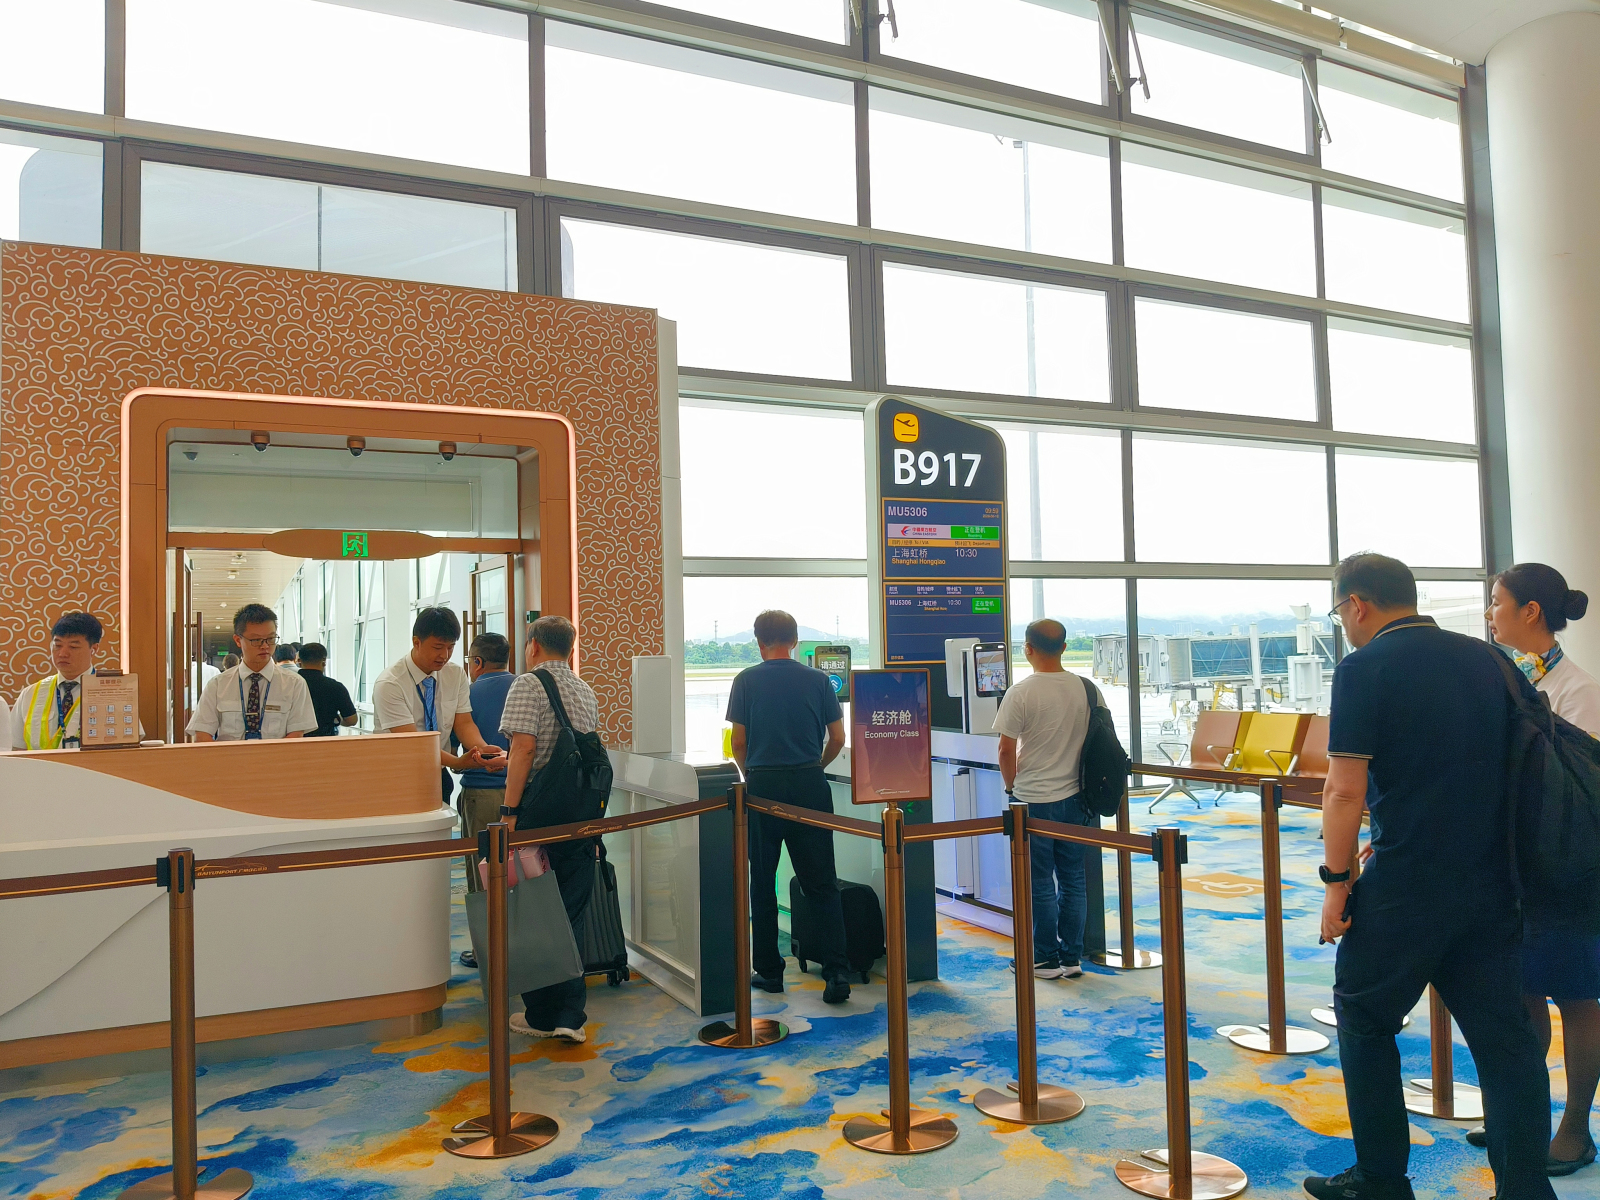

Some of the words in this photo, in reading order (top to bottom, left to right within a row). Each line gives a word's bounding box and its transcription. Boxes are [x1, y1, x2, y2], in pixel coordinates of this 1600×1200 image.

[893, 448, 982, 487] B917
[888, 506, 928, 517] MU5306
[964, 526, 986, 534] 正在登机
[892, 548, 928, 558] 上海虹桥
[955, 549, 978, 558] 10:30
[820, 660, 846, 670] 请通过
[872, 709, 912, 726] 经济舱
[864, 730, 898, 739] Economy
[899, 729, 920, 738] Class
